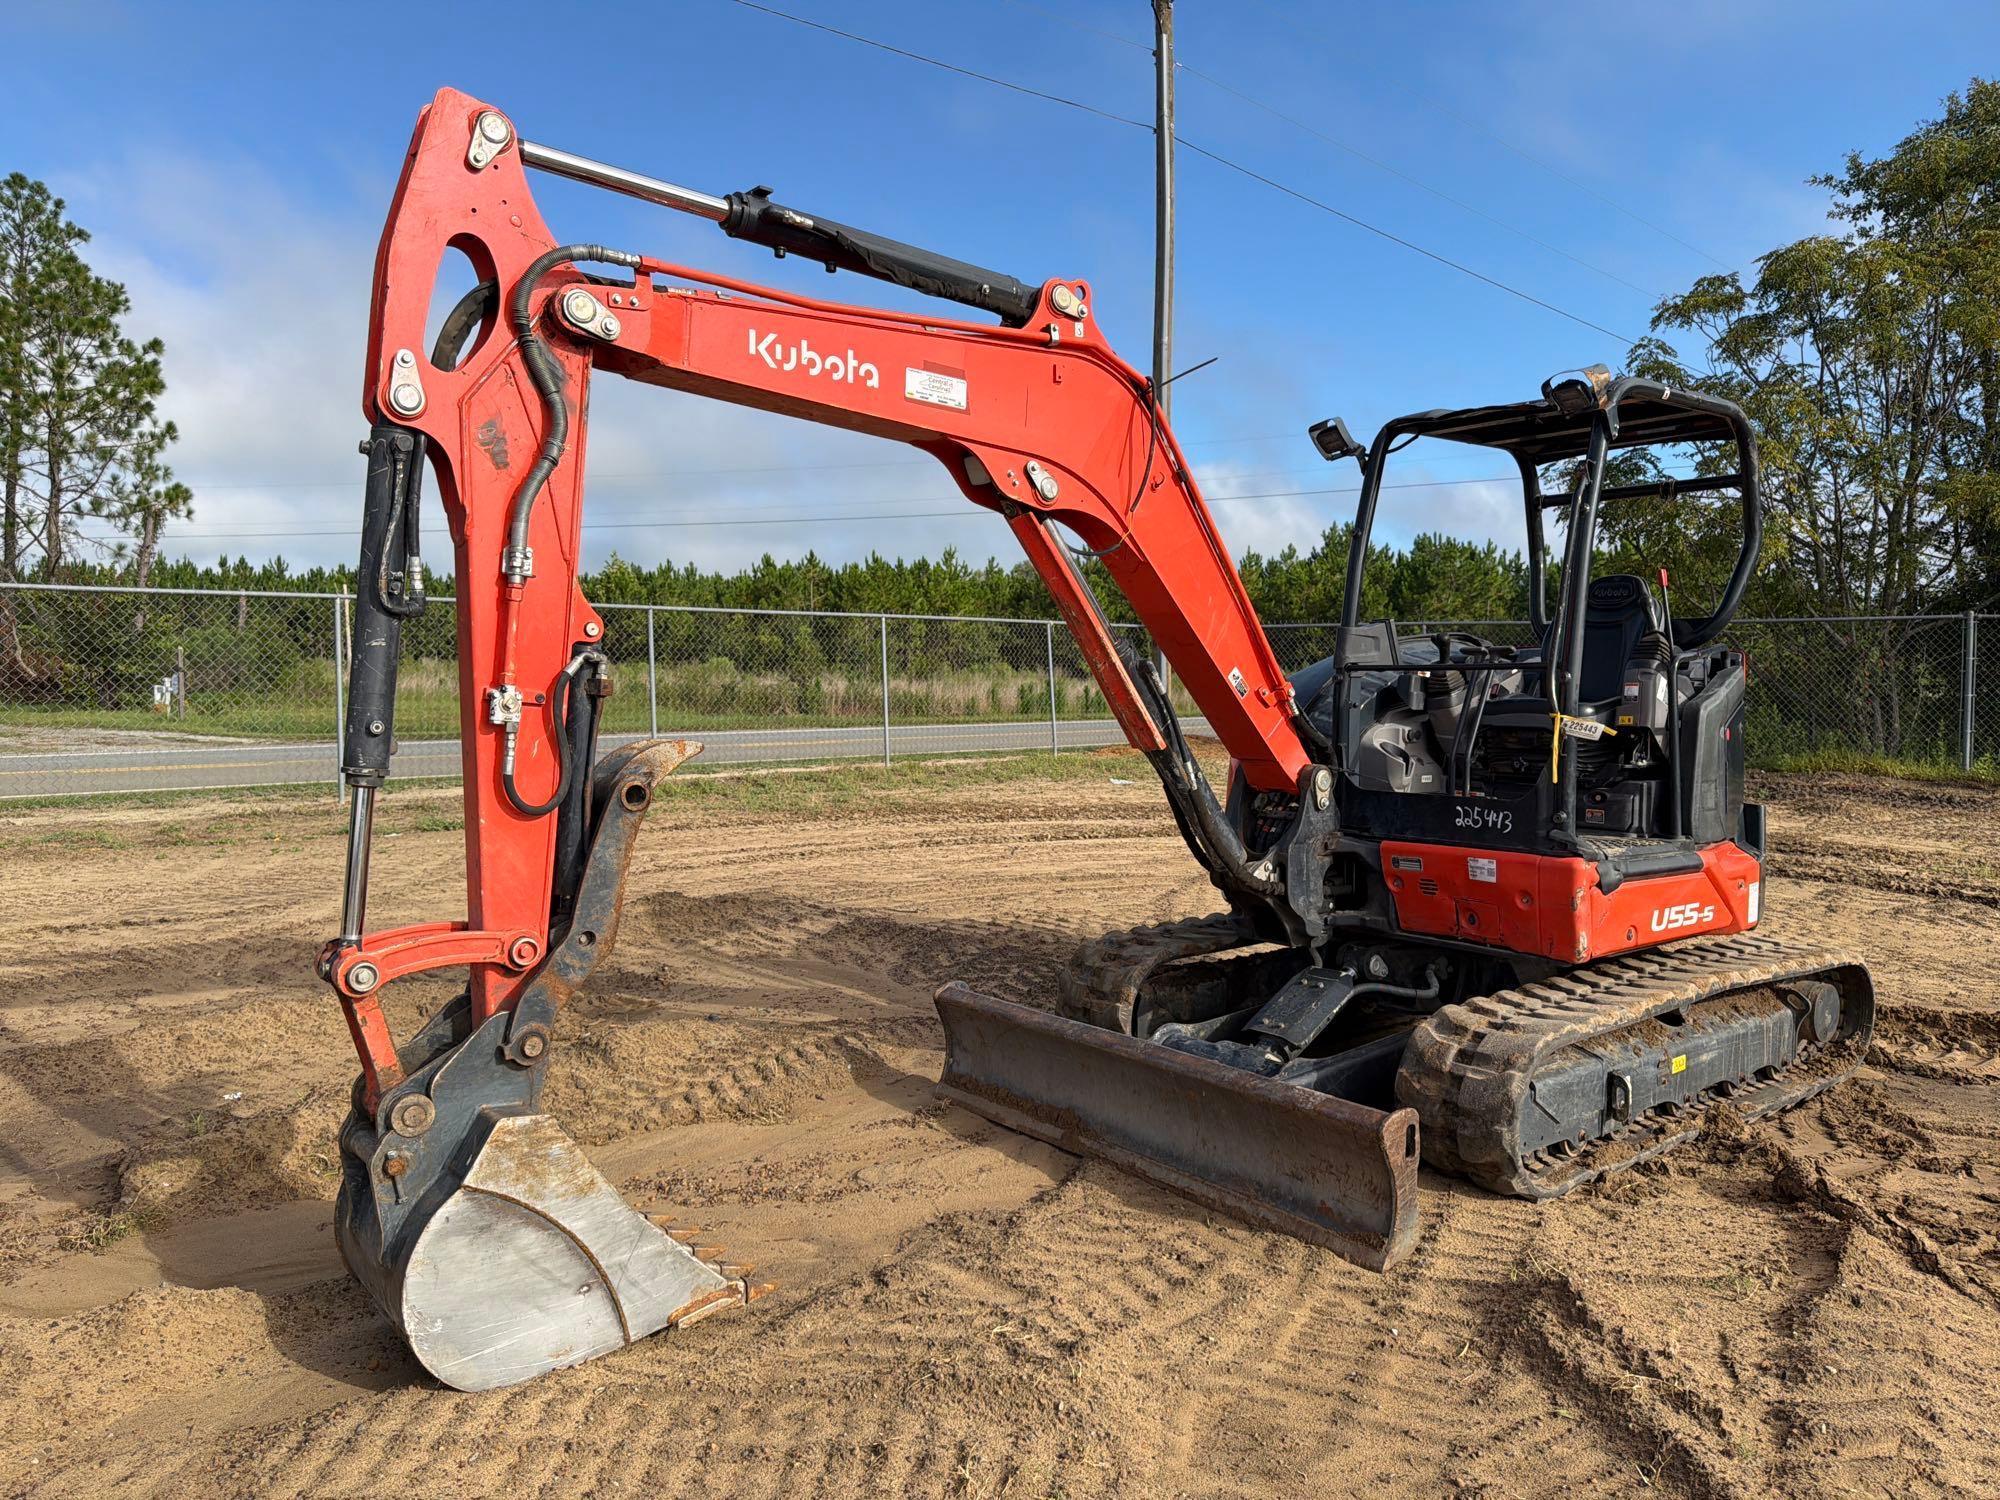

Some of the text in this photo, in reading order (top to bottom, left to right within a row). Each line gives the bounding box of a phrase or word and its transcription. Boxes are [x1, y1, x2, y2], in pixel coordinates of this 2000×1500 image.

[748, 328, 880, 389] Kubota
[1568, 721, 1598, 734] 225443
[1455, 805, 1512, 834] 225443
